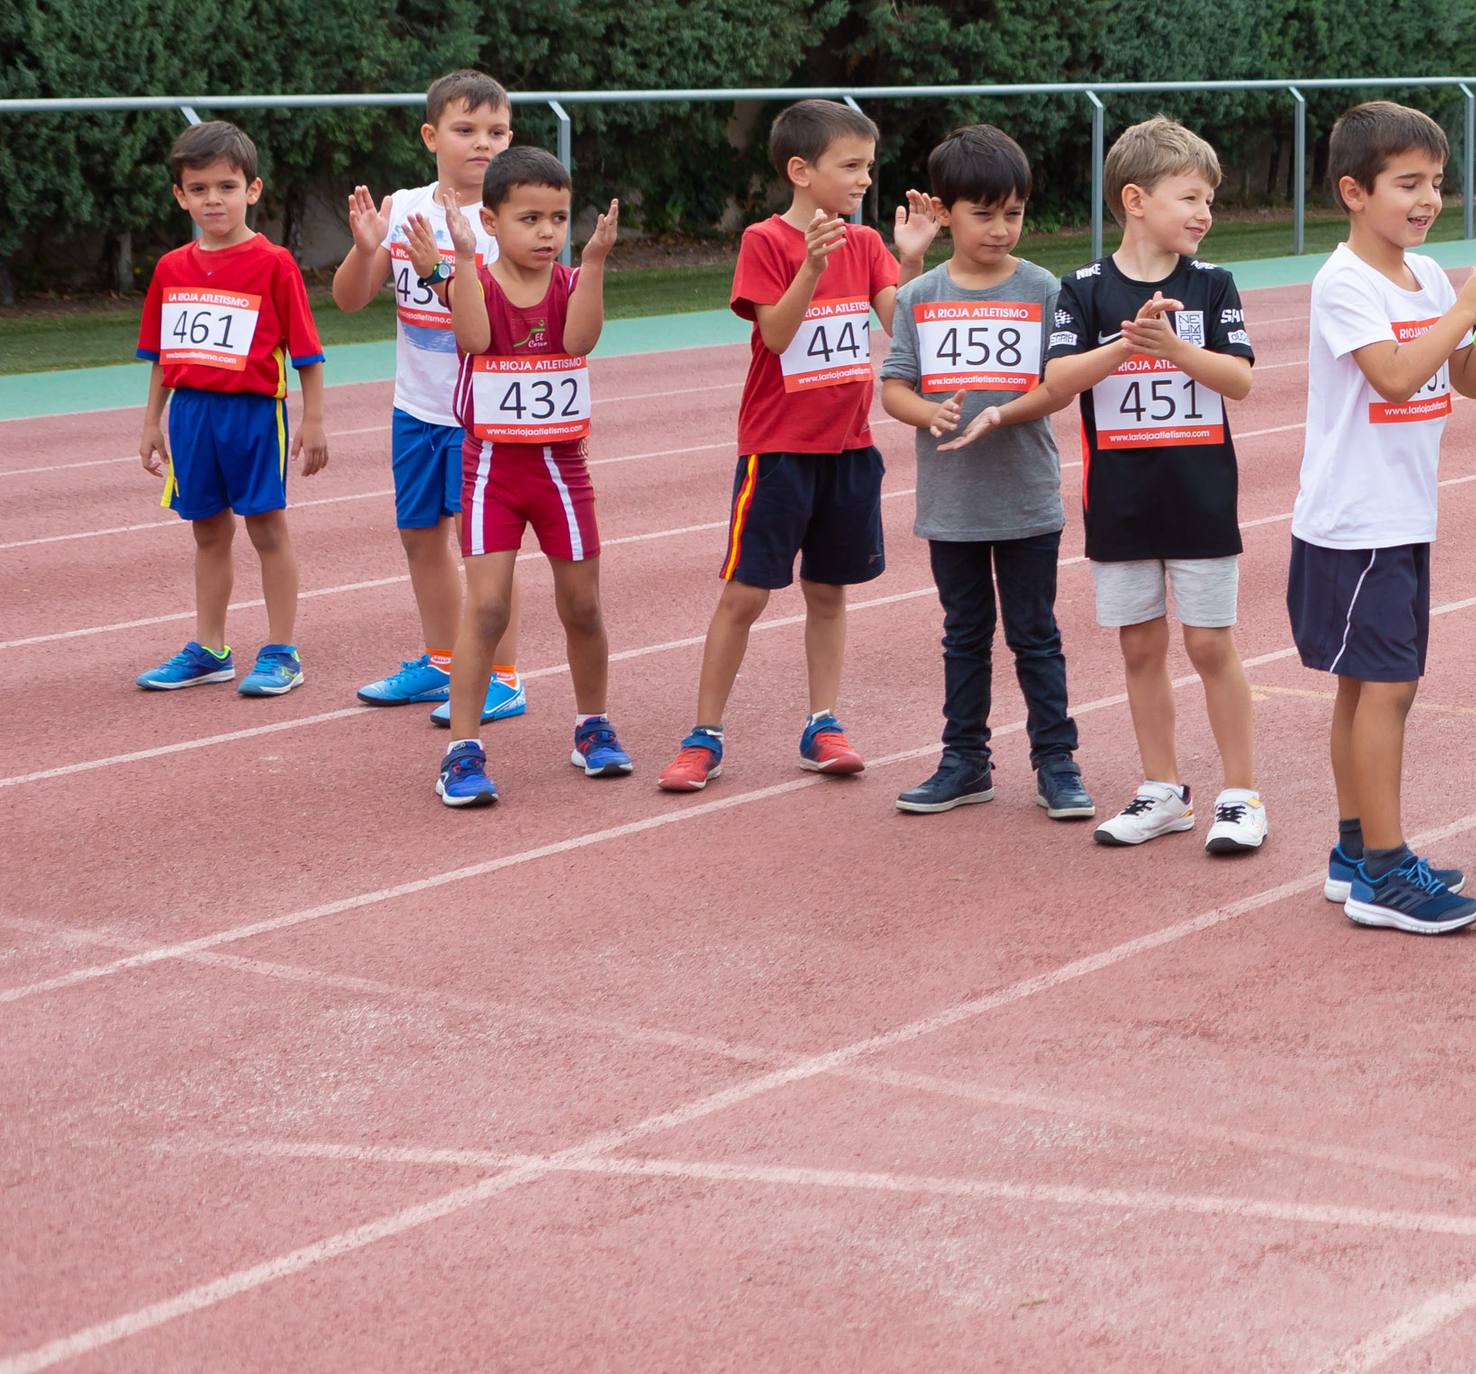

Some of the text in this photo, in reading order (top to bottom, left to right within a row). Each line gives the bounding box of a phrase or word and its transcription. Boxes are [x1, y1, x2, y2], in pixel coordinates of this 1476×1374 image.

[1076, 263, 1101, 280] NIKE
[169, 292, 249, 308] LA RIOJA ATLETISMO
[924, 307, 1029, 320] LA RIOJA ATLETISMO
[173, 310, 234, 348] 461
[936, 328, 1022, 367] 458
[486, 358, 582, 371] LA RIOJA ATLETISMO
[499, 378, 580, 420] 432
[1119, 379, 1203, 422] 451
